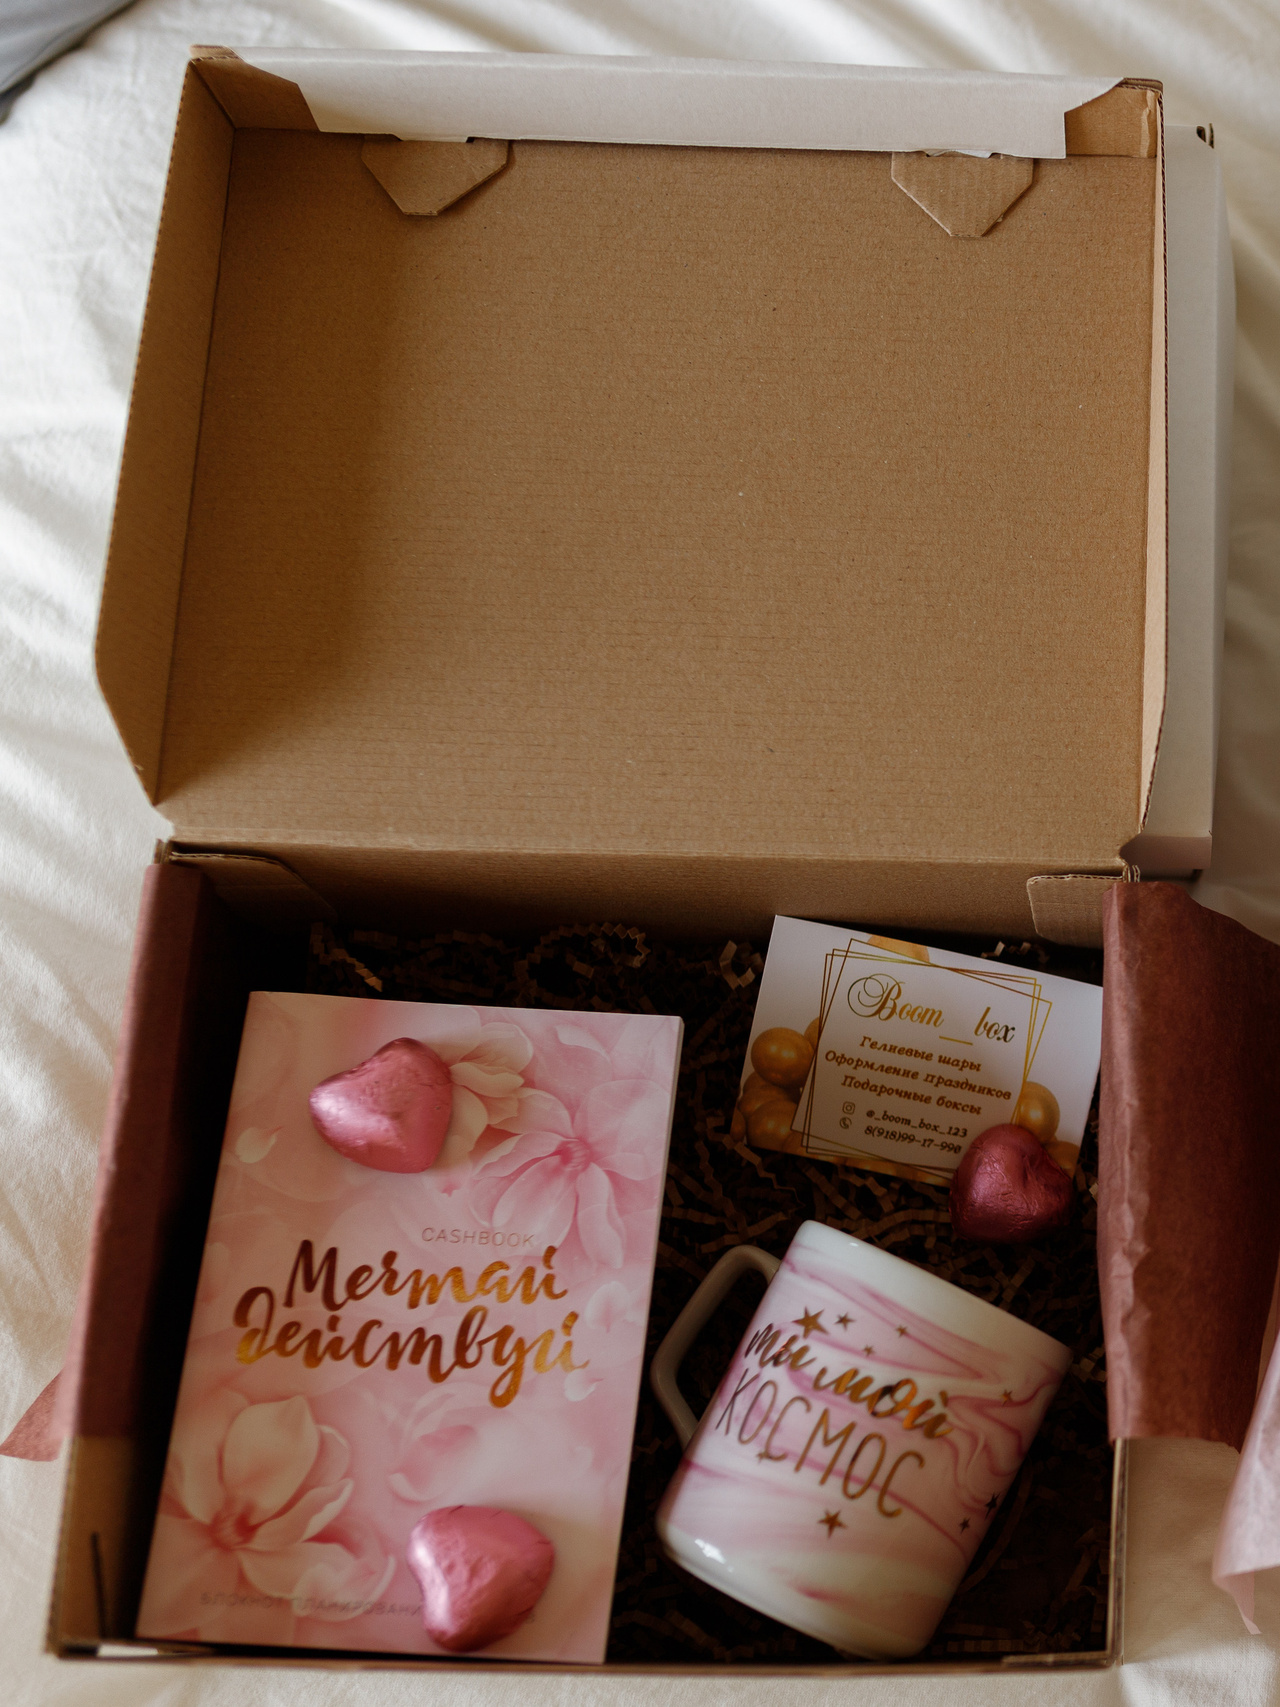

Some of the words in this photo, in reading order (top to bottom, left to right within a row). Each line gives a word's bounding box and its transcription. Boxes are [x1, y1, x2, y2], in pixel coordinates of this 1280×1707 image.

[825, 1050, 919, 1082] Оформление
[924, 1070, 1011, 1101] праздников
[860, 1035, 934, 1062] Гелиевые
[938, 1053, 982, 1073] шары
[841, 1074, 932, 1107] Подарочные
[937, 1095, 982, 1116] боксы
[866, 1108, 968, 1139] @_boom_box_123
[421, 1227, 535, 1247] CASHBOOK
[284, 1239, 567, 1311] Мечтай
[233, 1286, 589, 1408] Действуй
[715, 1368, 925, 1518] КОСМОС
